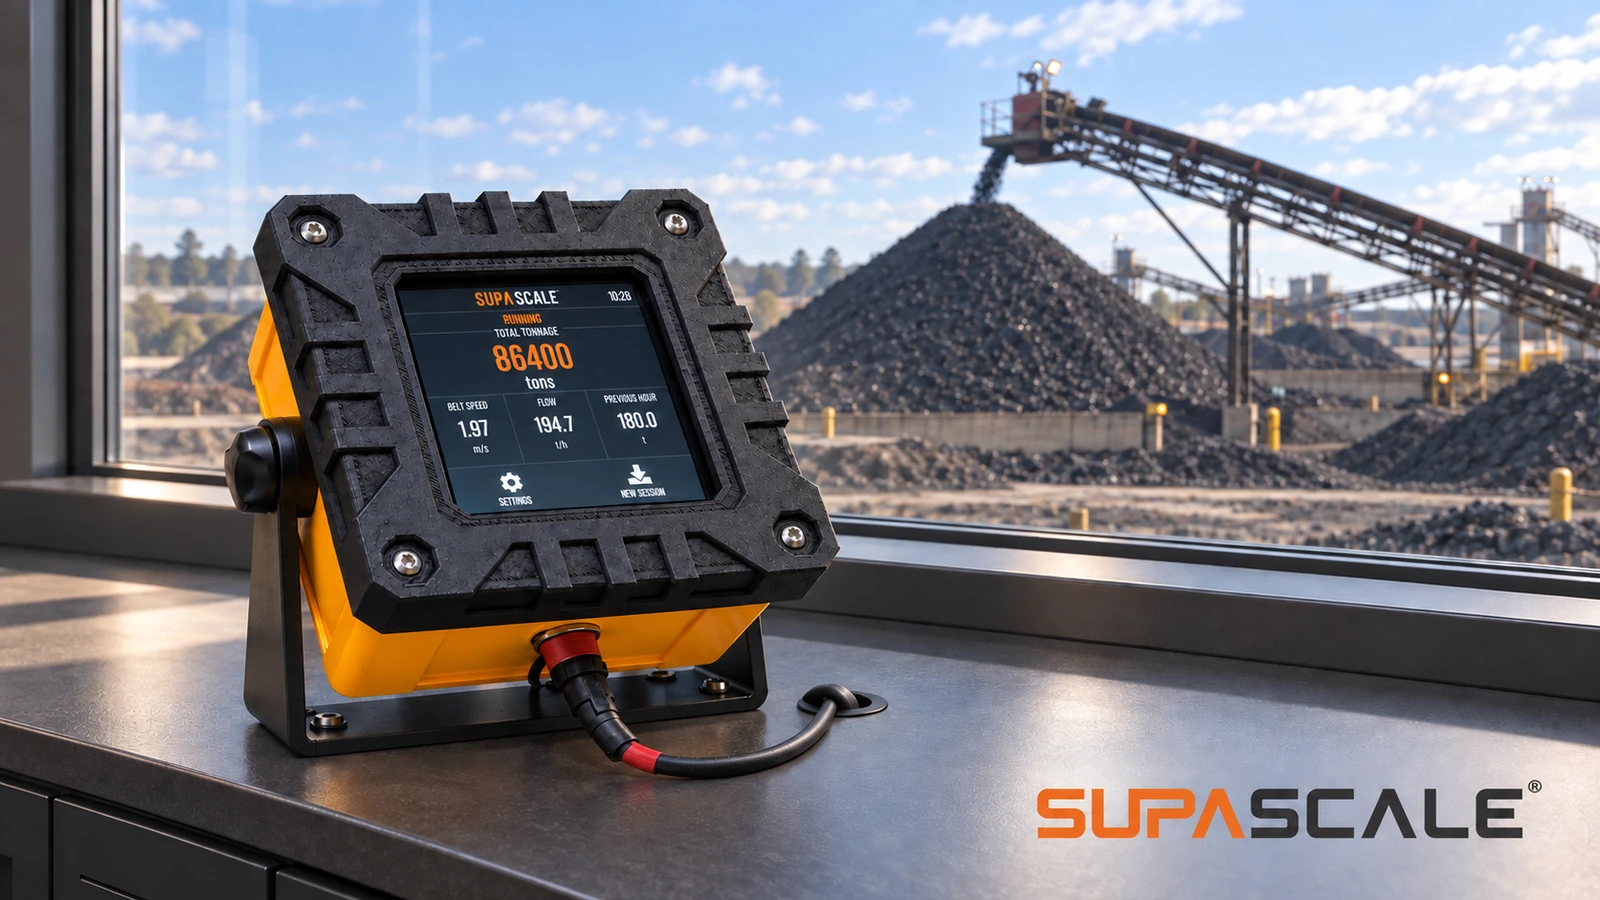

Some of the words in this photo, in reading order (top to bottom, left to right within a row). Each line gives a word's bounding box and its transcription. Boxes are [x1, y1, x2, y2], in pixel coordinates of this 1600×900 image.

[475, 291, 514, 307] SUPA
[514, 290, 559, 305] SCALE
[608, 290, 632, 302] 10:28
[494, 327, 520, 338] TOTAL
[520, 326, 559, 337] TONNAGE
[492, 342, 574, 372] 86400
[525, 375, 556, 390] tons
[537, 397, 557, 407] FLOW
[603, 394, 637, 404] PREVIOUS
[638, 393, 658, 402] HOUR
[447, 402, 464, 411] BELT
[465, 400, 489, 411] SPEED
[533, 415, 573, 434] 194.7
[616, 411, 658, 430] 180.0
[457, 419, 489, 438] 1.97
[555, 440, 569, 450] t/h
[641, 436, 647, 445] t
[472, 444, 490, 454] m/s
[620, 489, 637, 499] NEW
[637, 487, 666, 498] SESSION
[498, 496, 533, 507] SETTINGS
